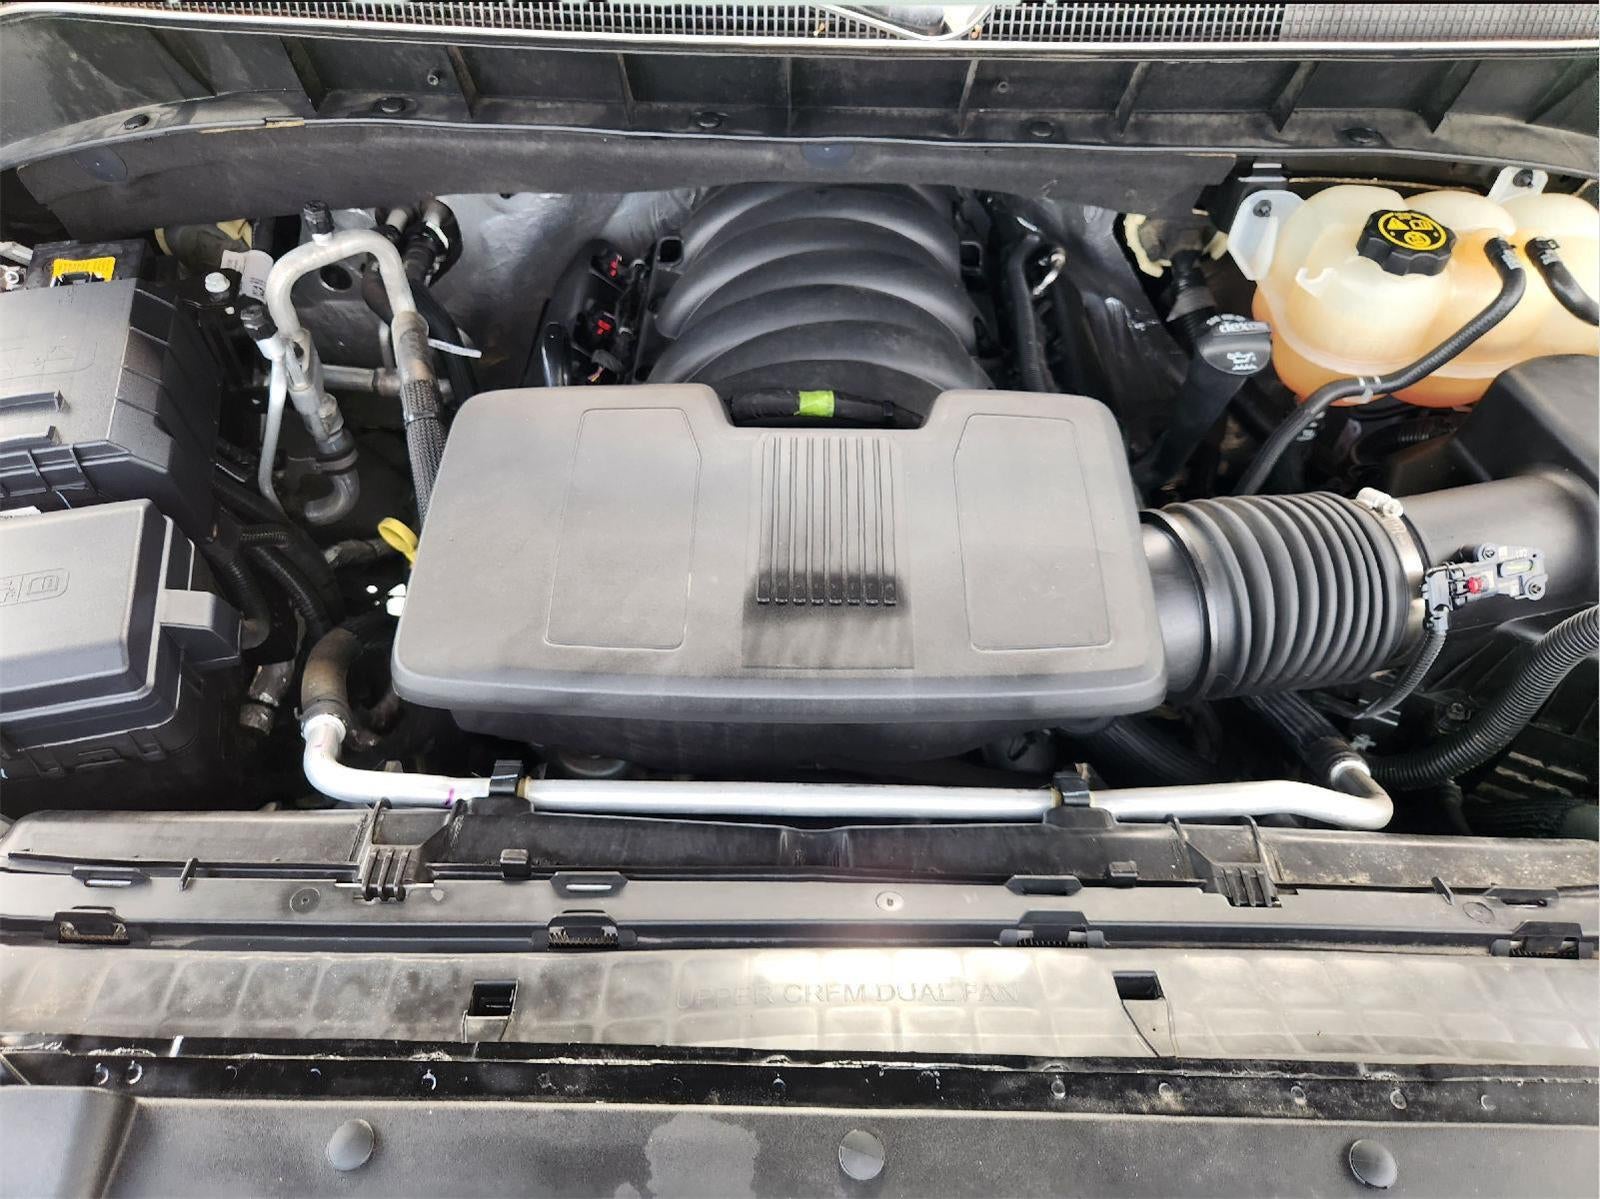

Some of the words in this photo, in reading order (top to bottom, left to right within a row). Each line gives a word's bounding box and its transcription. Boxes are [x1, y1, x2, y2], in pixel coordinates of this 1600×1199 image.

[675, 983, 776, 1010] UPPER
[876, 983, 956, 1003] DUAL
[961, 983, 1020, 1004] FAN
